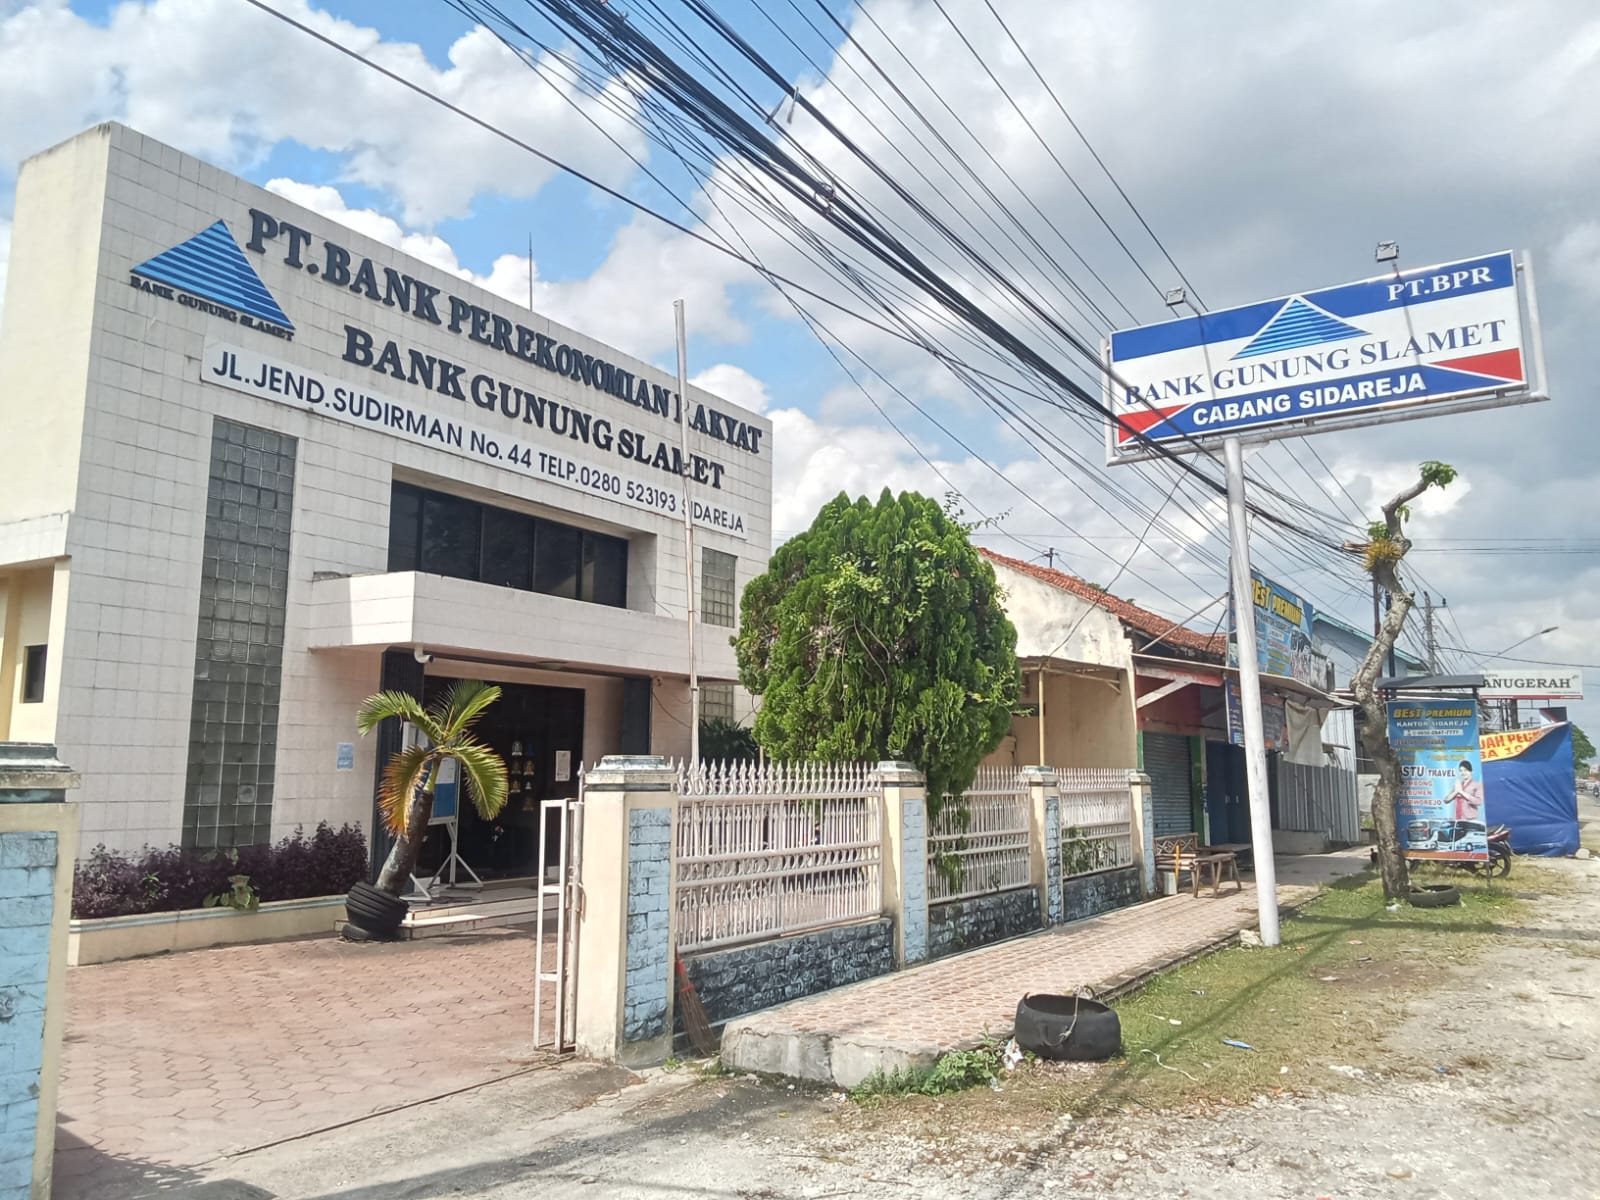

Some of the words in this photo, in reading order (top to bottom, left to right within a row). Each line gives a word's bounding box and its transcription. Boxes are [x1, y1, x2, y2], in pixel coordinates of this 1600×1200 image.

[1387, 265, 1494, 302] PT.BPR
[130, 275, 175, 301] BANK
[177, 293, 238, 323] GUNUNG
[239, 314, 295, 342] SLAMET
[447, 294, 671, 422] PEREKONOMIAN
[1125, 373, 1206, 405] BANK
[1213, 347, 1350, 391] GUNUNG
[1359, 318, 1506, 365] SLAMET
[342, 324, 467, 402] BANK
[470, 374, 612, 452] GUNUNG
[617, 428, 725, 490] SLAMET
[1192, 390, 1291, 426] CABANG
[1298, 371, 1426, 410] SIDAREJA
[625, 480, 676, 513] 523193
[1483, 678, 1571, 689] ANUGERAH
[1425, 708, 1473, 717] PREMIUM
[1428, 769, 1456, 777] TRAVEL
